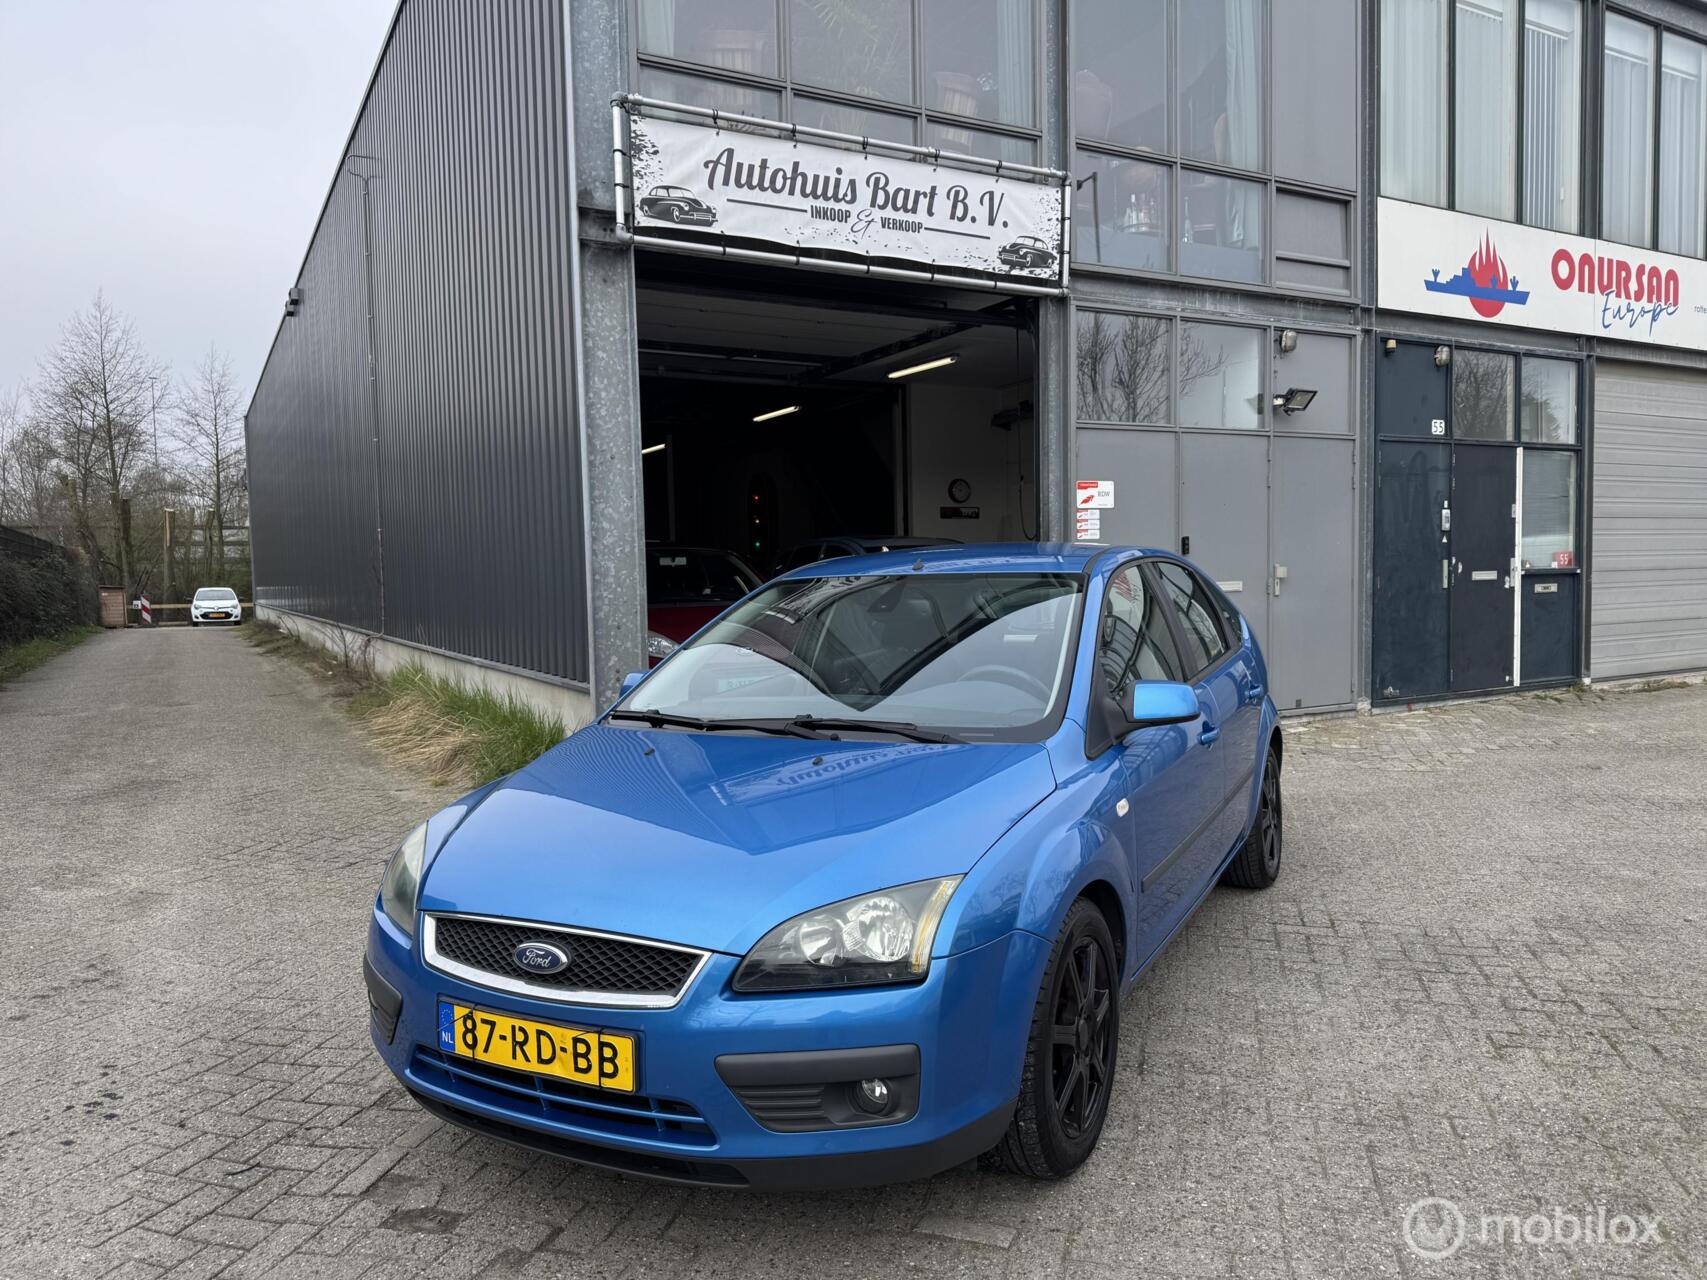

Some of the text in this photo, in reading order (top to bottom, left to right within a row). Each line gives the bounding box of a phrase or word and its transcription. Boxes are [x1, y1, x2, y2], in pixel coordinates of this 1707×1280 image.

[703, 147, 1009, 229] Autohuis Bart B.V.
[810, 205, 851, 224] INKOOP
[880, 217, 924, 234] VERKOOP
[1551, 248, 1679, 307] ONURSAN
[1601, 289, 1679, 336] Europe
[1433, 420, 1444, 434] 55
[1559, 553, 1569, 565] 55
[522, 948, 552, 968] Ford
[441, 1030, 454, 1044] NL
[461, 1011, 620, 1080] 87-RD-BB
